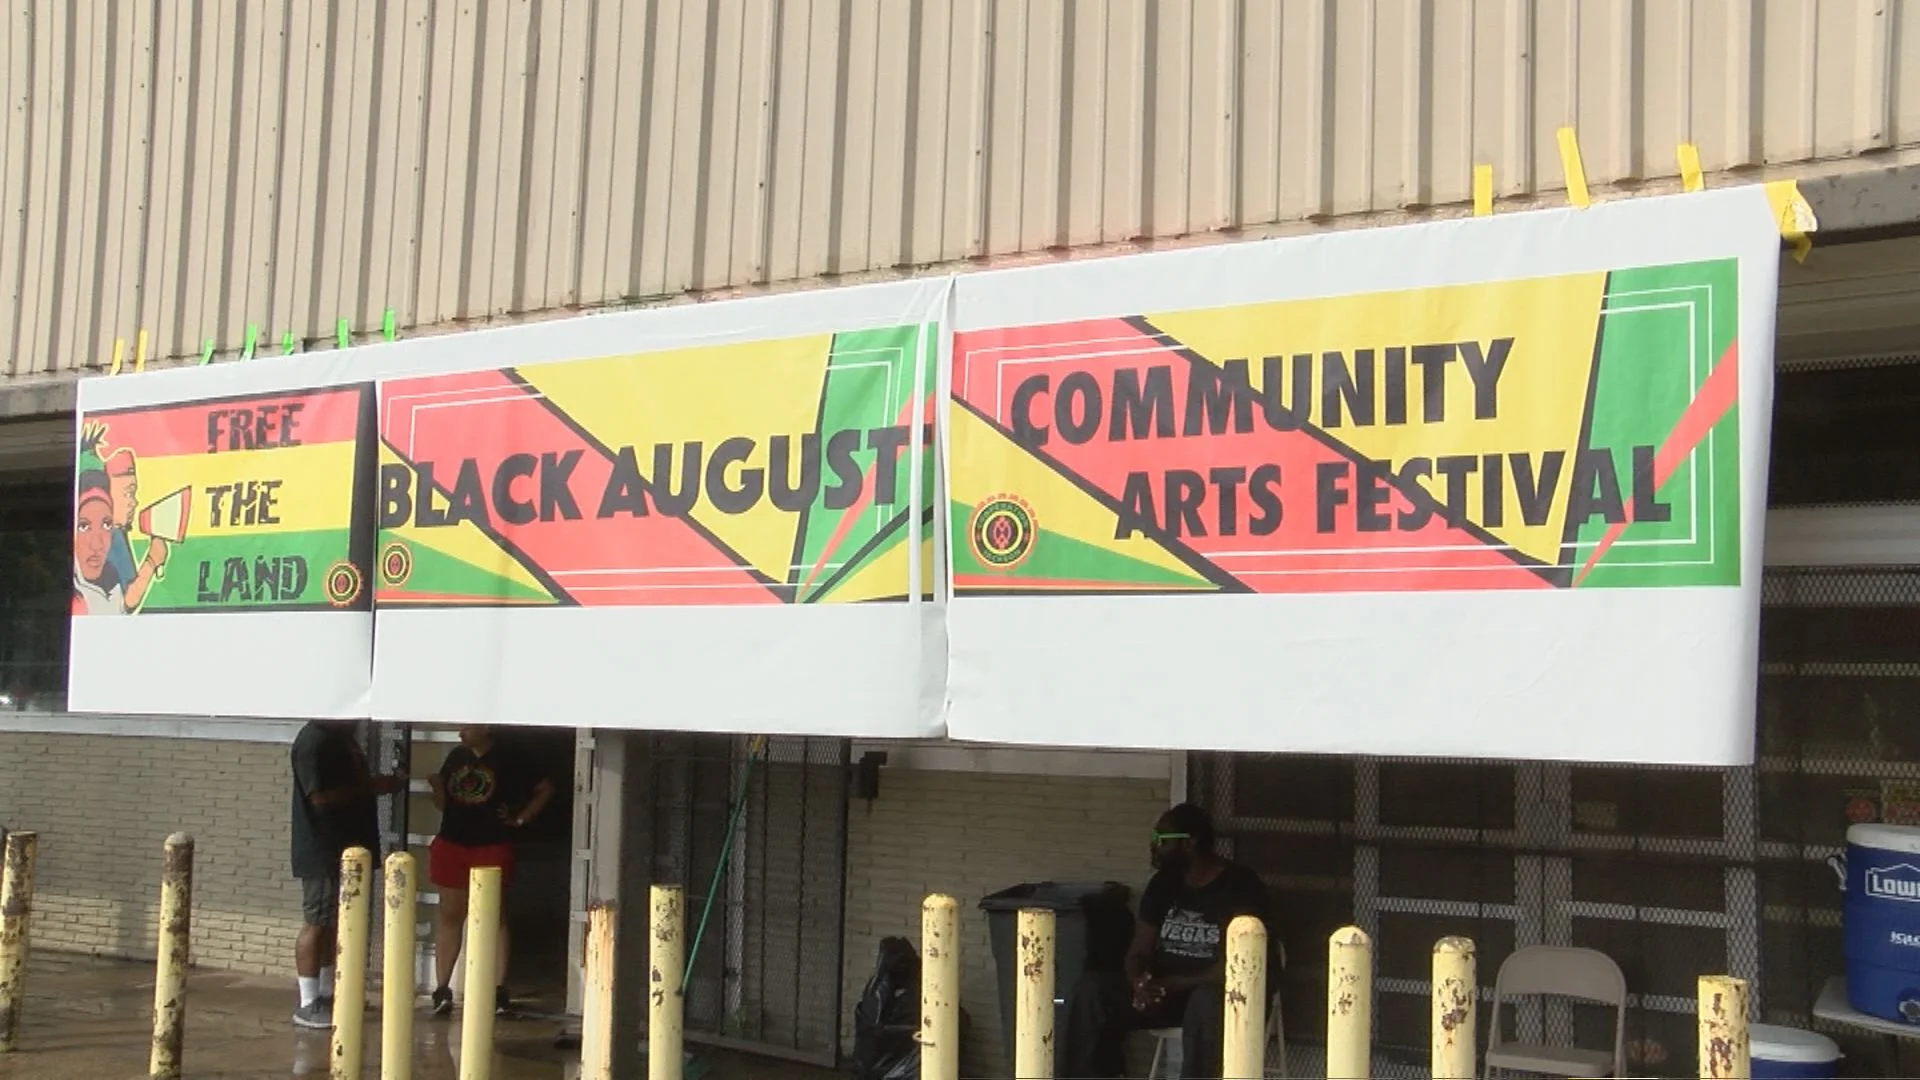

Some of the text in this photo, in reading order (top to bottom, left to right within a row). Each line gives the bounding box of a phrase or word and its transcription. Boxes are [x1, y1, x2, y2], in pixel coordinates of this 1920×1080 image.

[1011, 338, 1515, 446] COMMUNITY
[206, 403, 304, 454] FREE
[381, 424, 933, 528] BLACK AUGUST
[1115, 445, 1671, 540] ARTS FESTIVAL
[205, 480, 283, 527] THE
[196, 555, 309, 602] LAND
[1160, 921, 1220, 943] VEGAS
